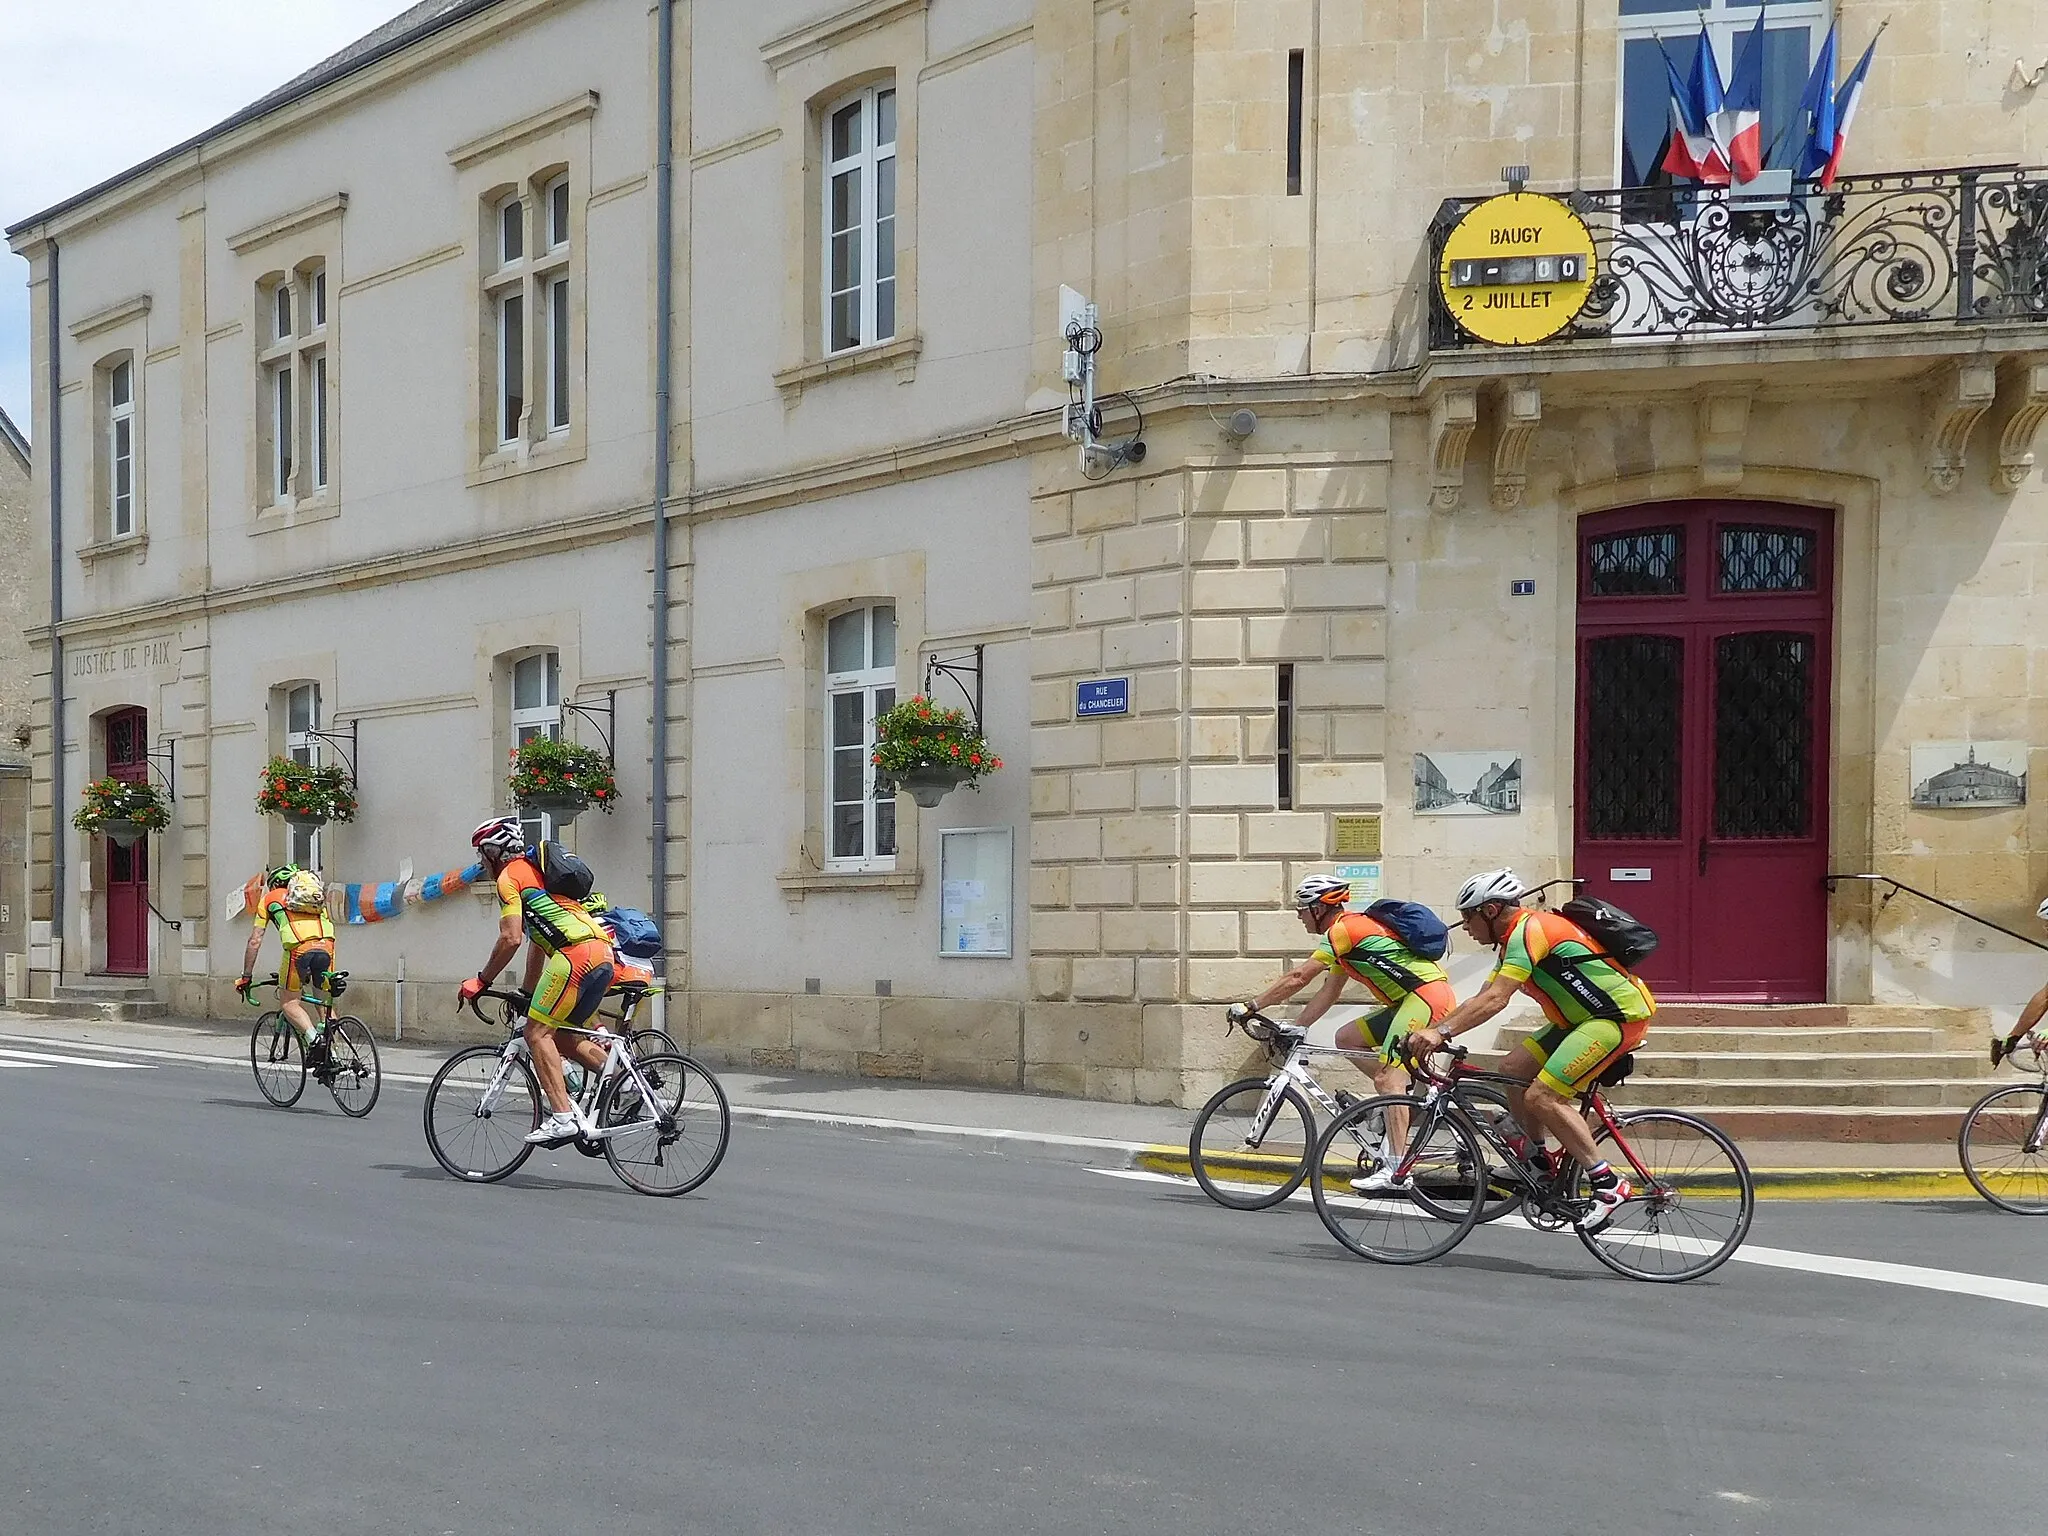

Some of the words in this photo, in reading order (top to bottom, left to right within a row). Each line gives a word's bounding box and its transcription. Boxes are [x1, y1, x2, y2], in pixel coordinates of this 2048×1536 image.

[1490, 228, 1542, 244] BAUGY
[1463, 294, 1474, 310] 2
[1483, 292, 1552, 309] JUILLET
[1520, 582, 1526, 593] 1
[73, 651, 117, 677] JUSTICE
[123, 647, 137, 670] DE
[144, 641, 170, 667] PAIX
[1095, 686, 1108, 696] RUE
[1087, 697, 1124, 709] CHANCELIER
[1352, 867, 1377, 877] DAE
[1560, 970, 1575, 981] JS
[538, 972, 558, 1006] CAILLAT
[1561, 1040, 1602, 1075] CAILLAT
